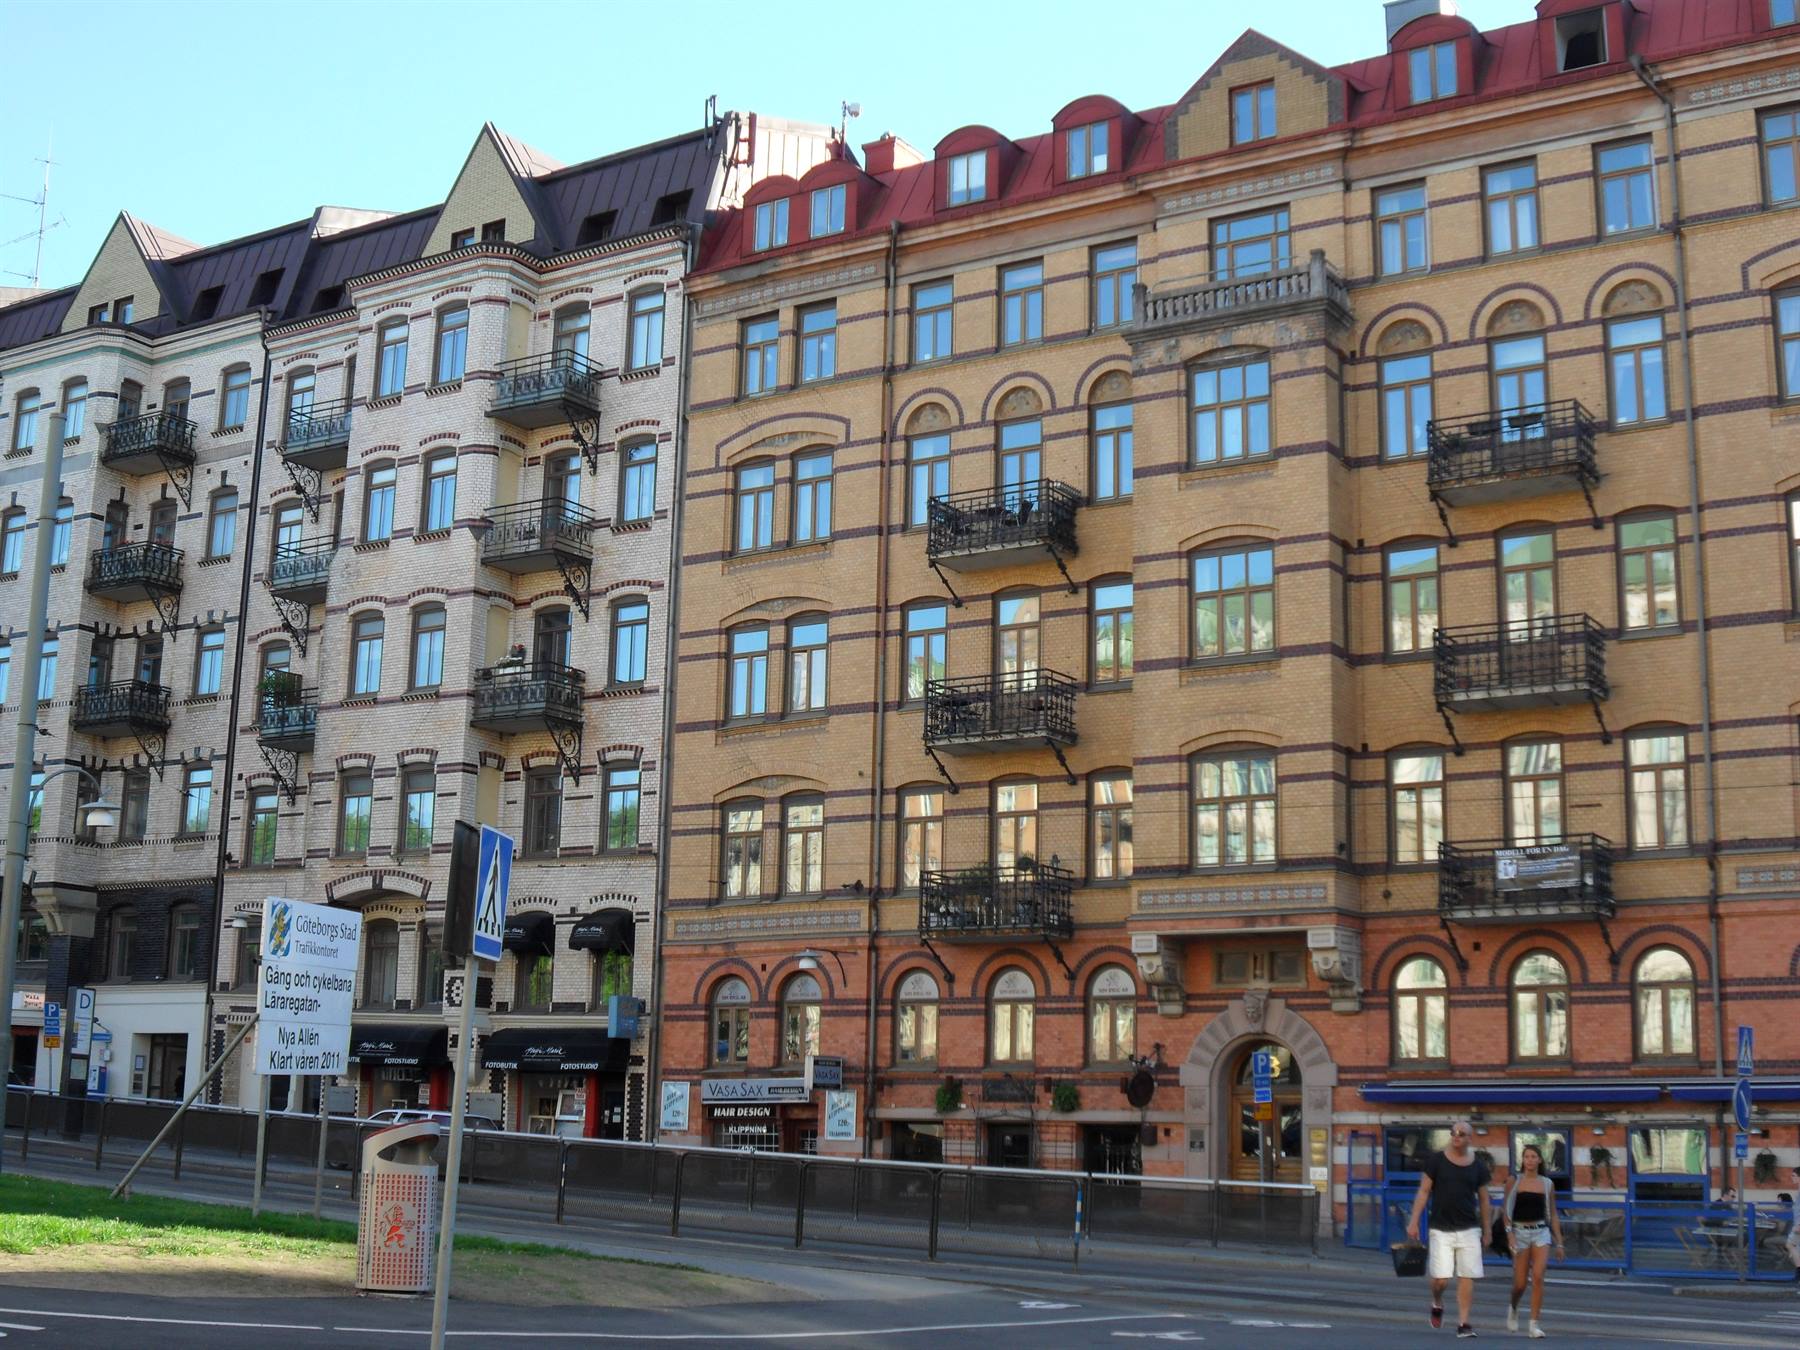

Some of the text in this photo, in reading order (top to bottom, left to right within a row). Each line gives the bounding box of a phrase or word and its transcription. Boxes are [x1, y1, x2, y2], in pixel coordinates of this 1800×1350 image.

[296, 915, 357, 942] Göteborgs Stad
[295, 940, 338, 958] Trafikkontoret
[266, 965, 352, 994] Gång och cykelbana
[48, 1004, 56, 1016] P
[80, 993, 91, 1009] D
[264, 990, 321, 1016] Läraregatan-
[278, 1026, 320, 1050] Nya Allén
[270, 1050, 340, 1071] Klart våren 2011
[485, 1061, 518, 1070] FOTOBUTIK
[1258, 1054, 1267, 1074] P
[709, 1082, 763, 1097] VASA SAX
[714, 1107, 770, 1117] HAIR DESIGN
[728, 1126, 767, 1134] KLIPPNING
